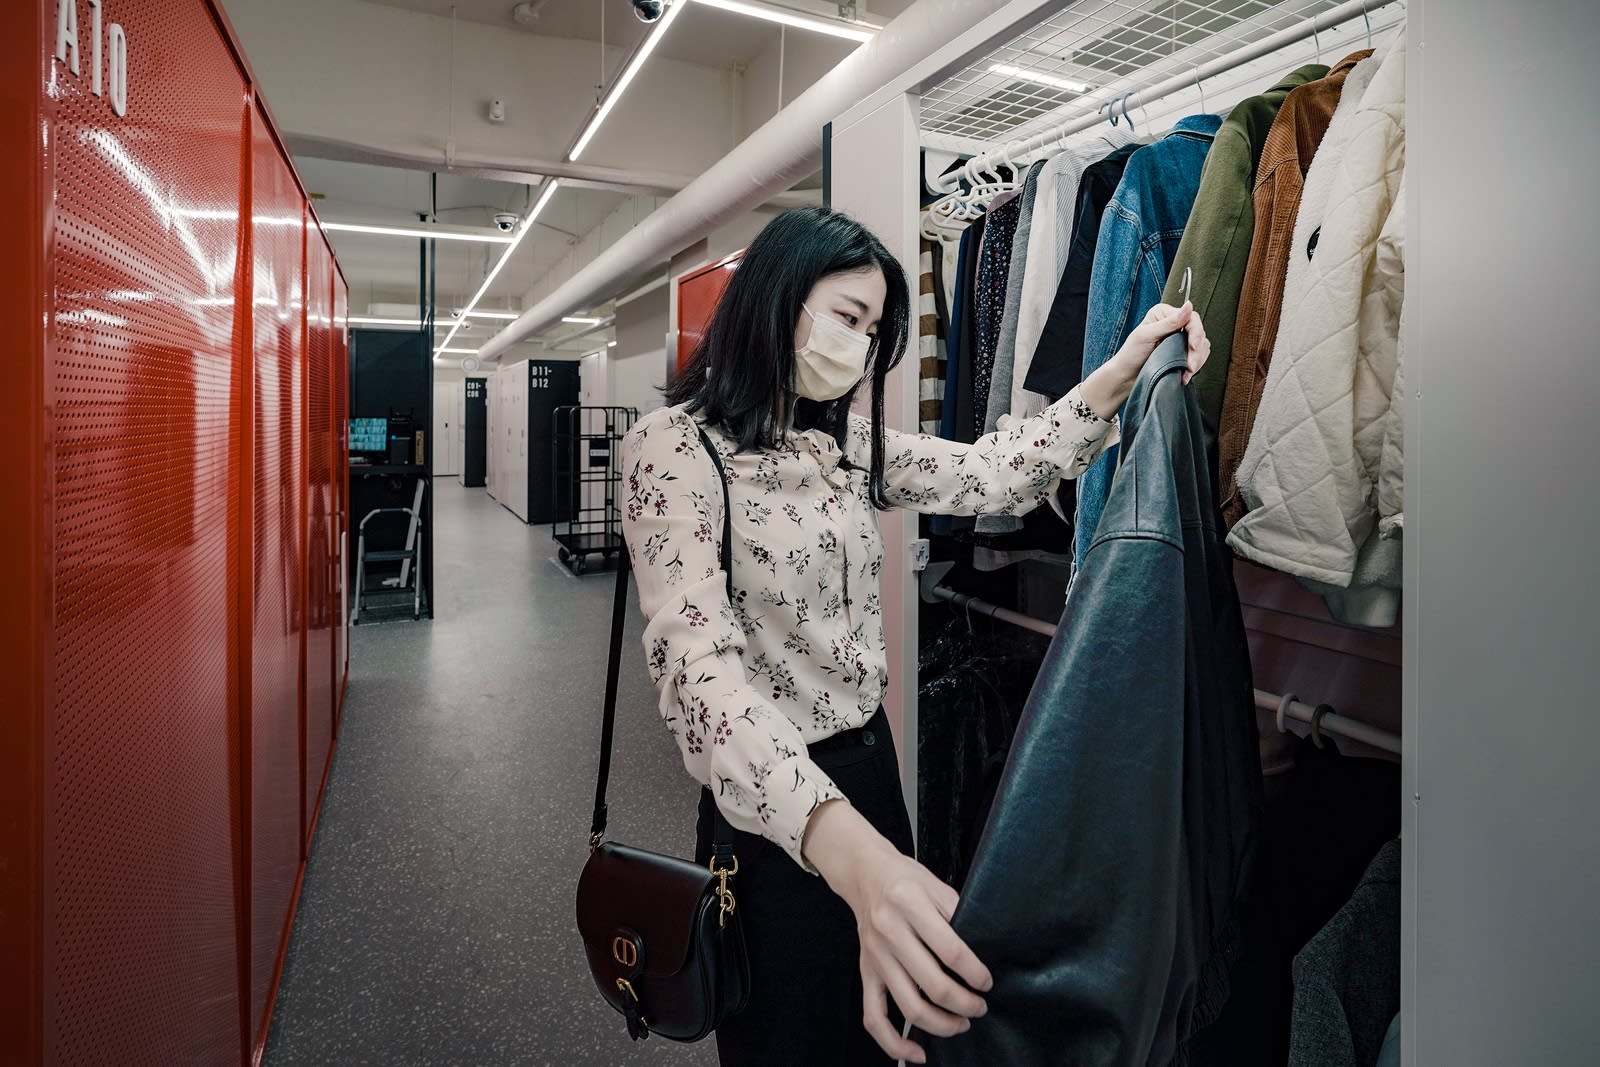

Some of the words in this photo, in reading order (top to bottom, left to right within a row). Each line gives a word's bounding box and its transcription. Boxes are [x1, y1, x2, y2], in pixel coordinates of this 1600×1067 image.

[56, 0, 127, 117] A10
[532, 366, 552, 376] B11-
[532, 378, 549, 388] B12
